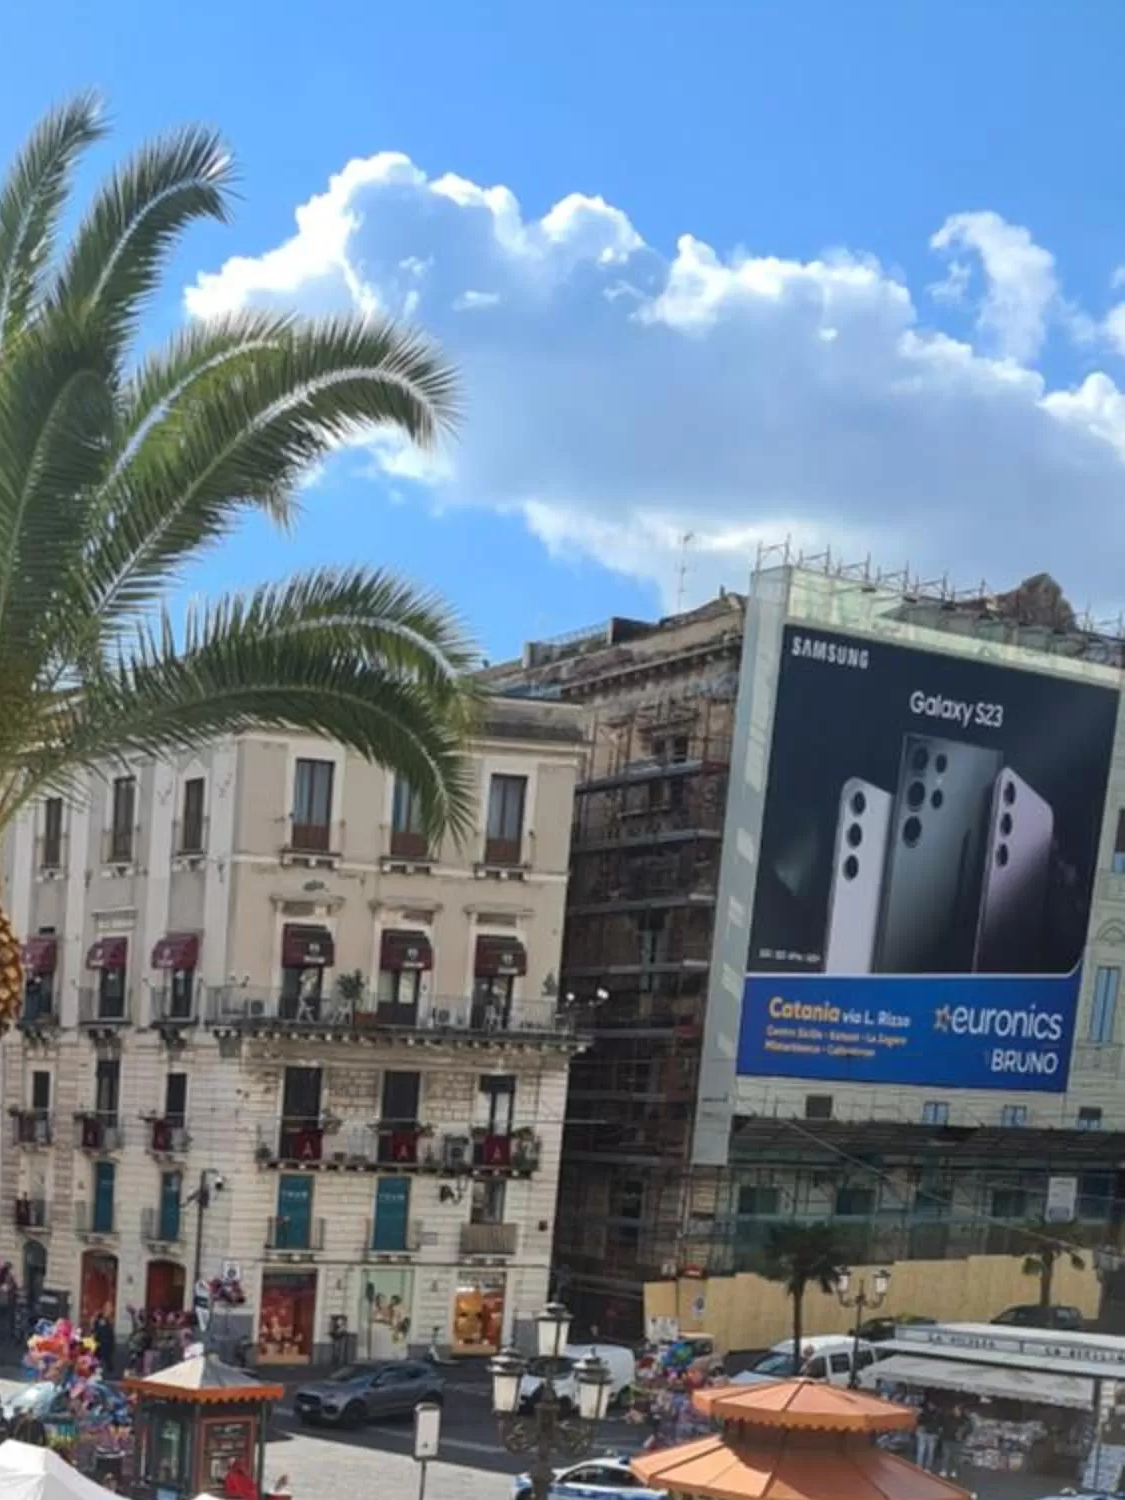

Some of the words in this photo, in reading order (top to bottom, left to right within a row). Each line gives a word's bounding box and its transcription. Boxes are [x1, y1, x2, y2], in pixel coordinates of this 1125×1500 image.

[791, 636, 869, 669] SAMSUNG
[910, 690, 973, 728] Galaxy
[975, 702, 1004, 728] S23
[769, 996, 841, 1023] Catania
[952, 1002, 1063, 1040] euronics
[990, 1048, 1059, 1074] BRUNO
